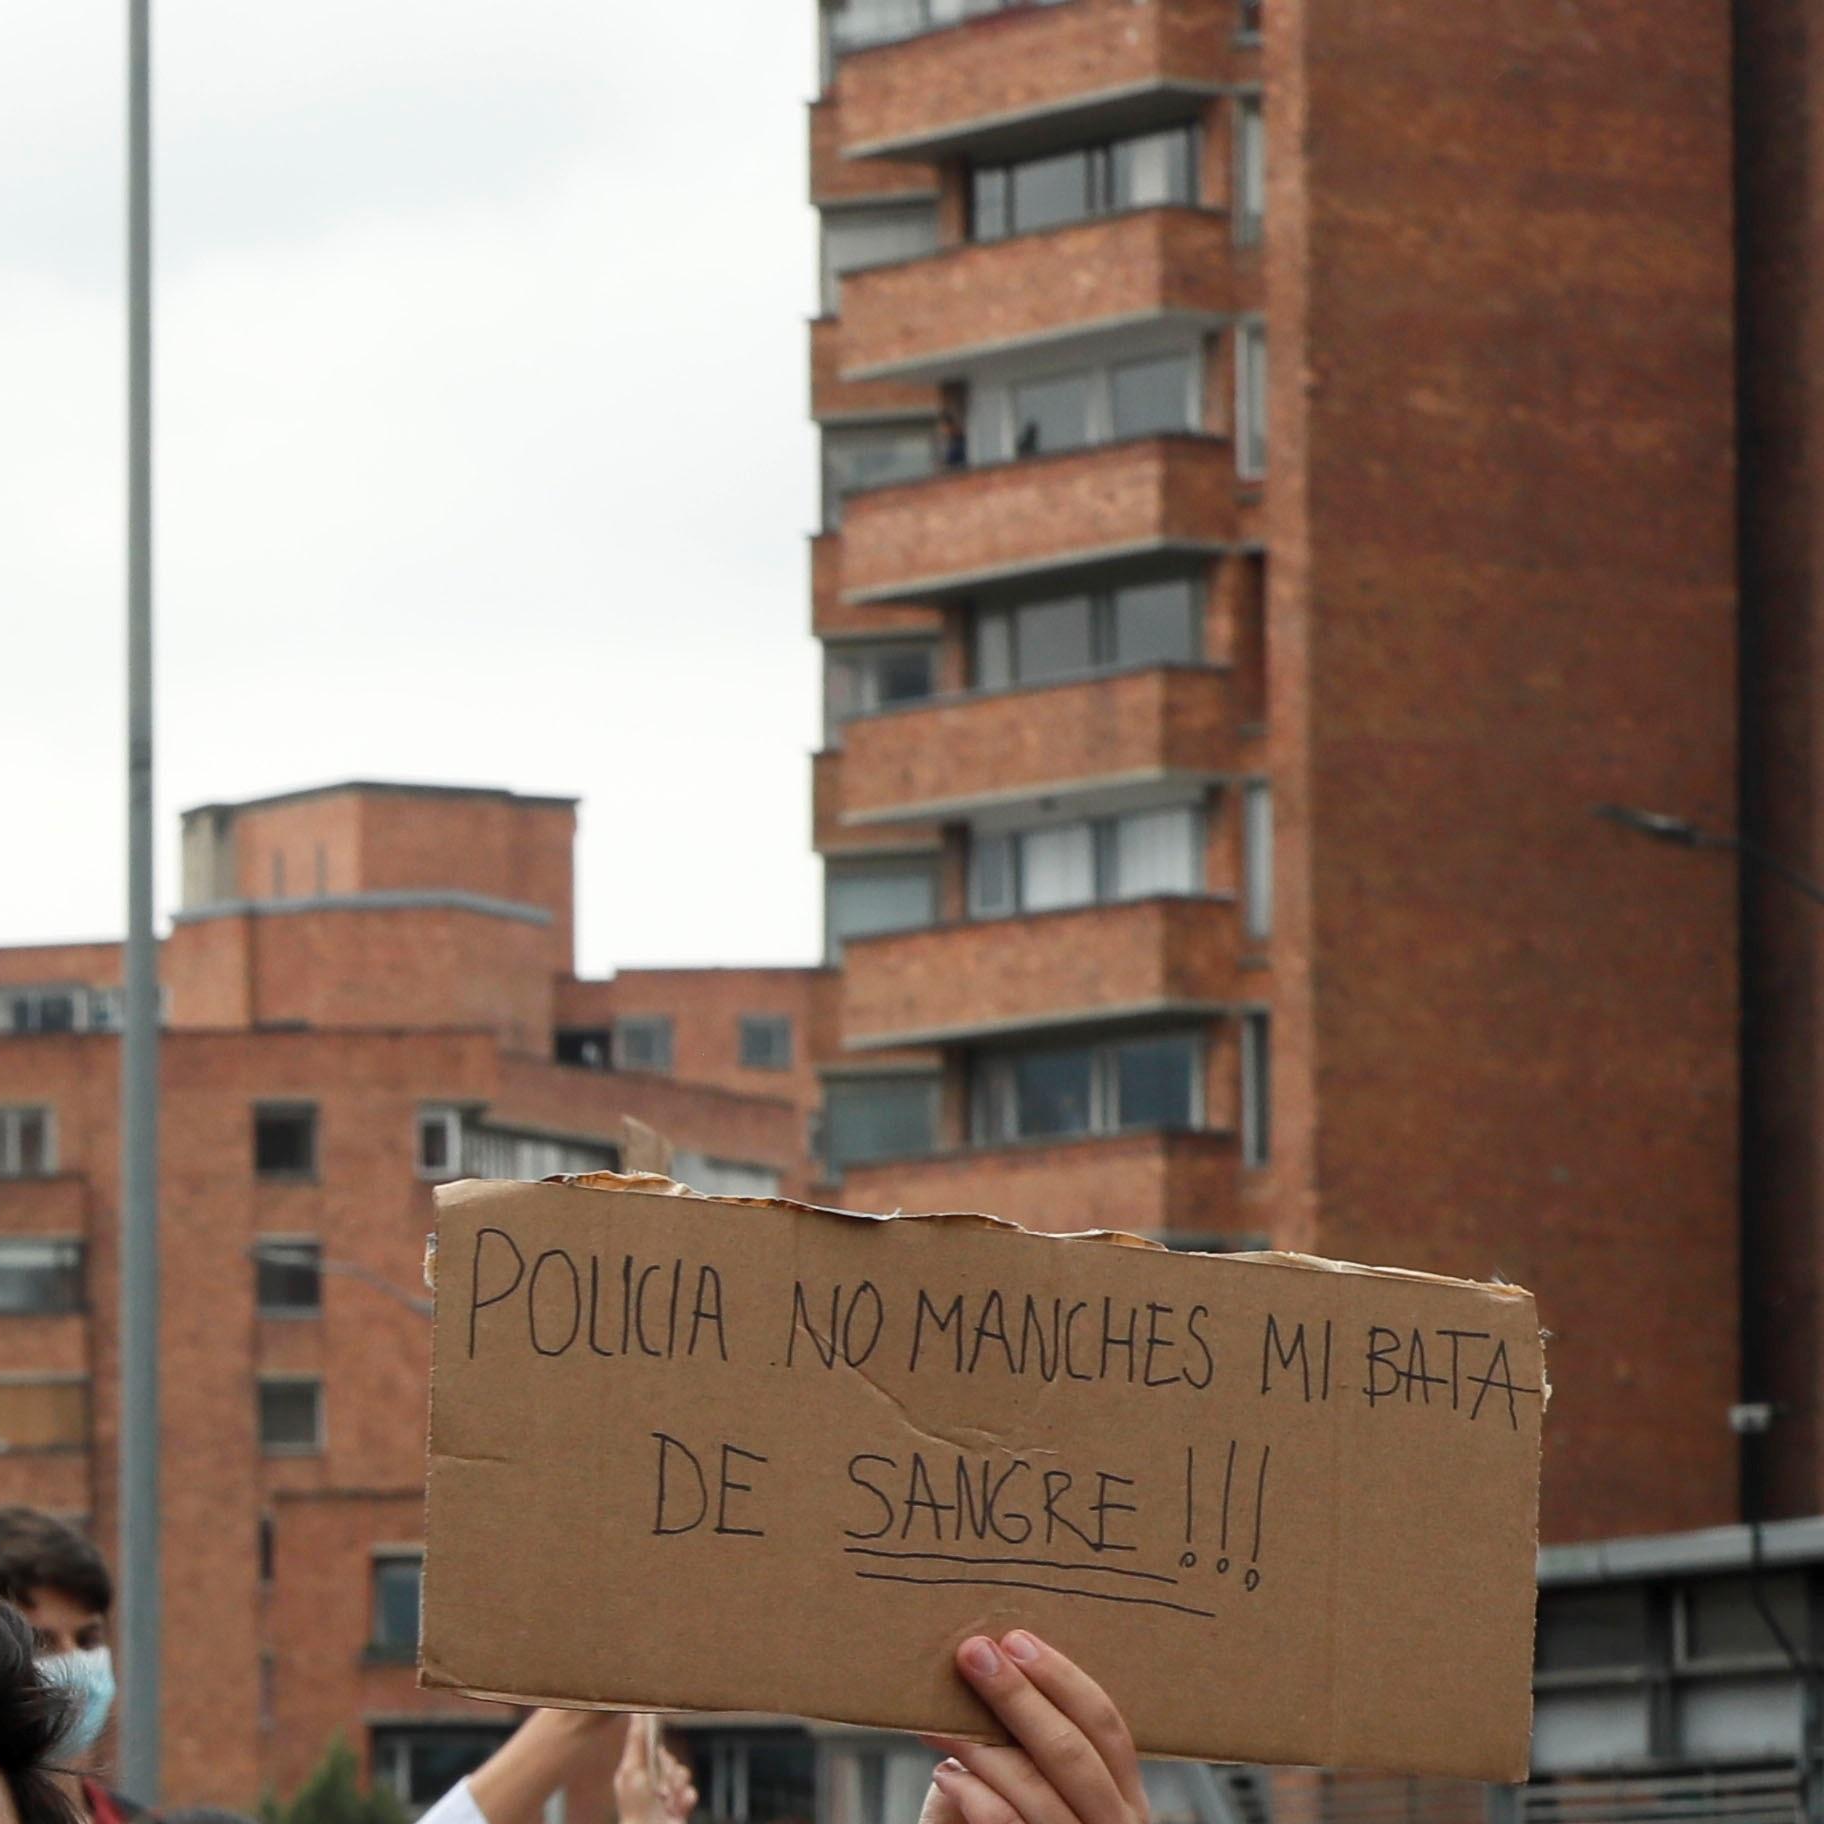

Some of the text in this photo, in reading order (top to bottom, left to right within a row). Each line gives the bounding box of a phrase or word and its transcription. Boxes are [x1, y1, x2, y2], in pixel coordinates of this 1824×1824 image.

[468, 1229, 1543, 1430] POLICIA NO MANCHES MI BATA
[651, 1433, 767, 1537] DE
